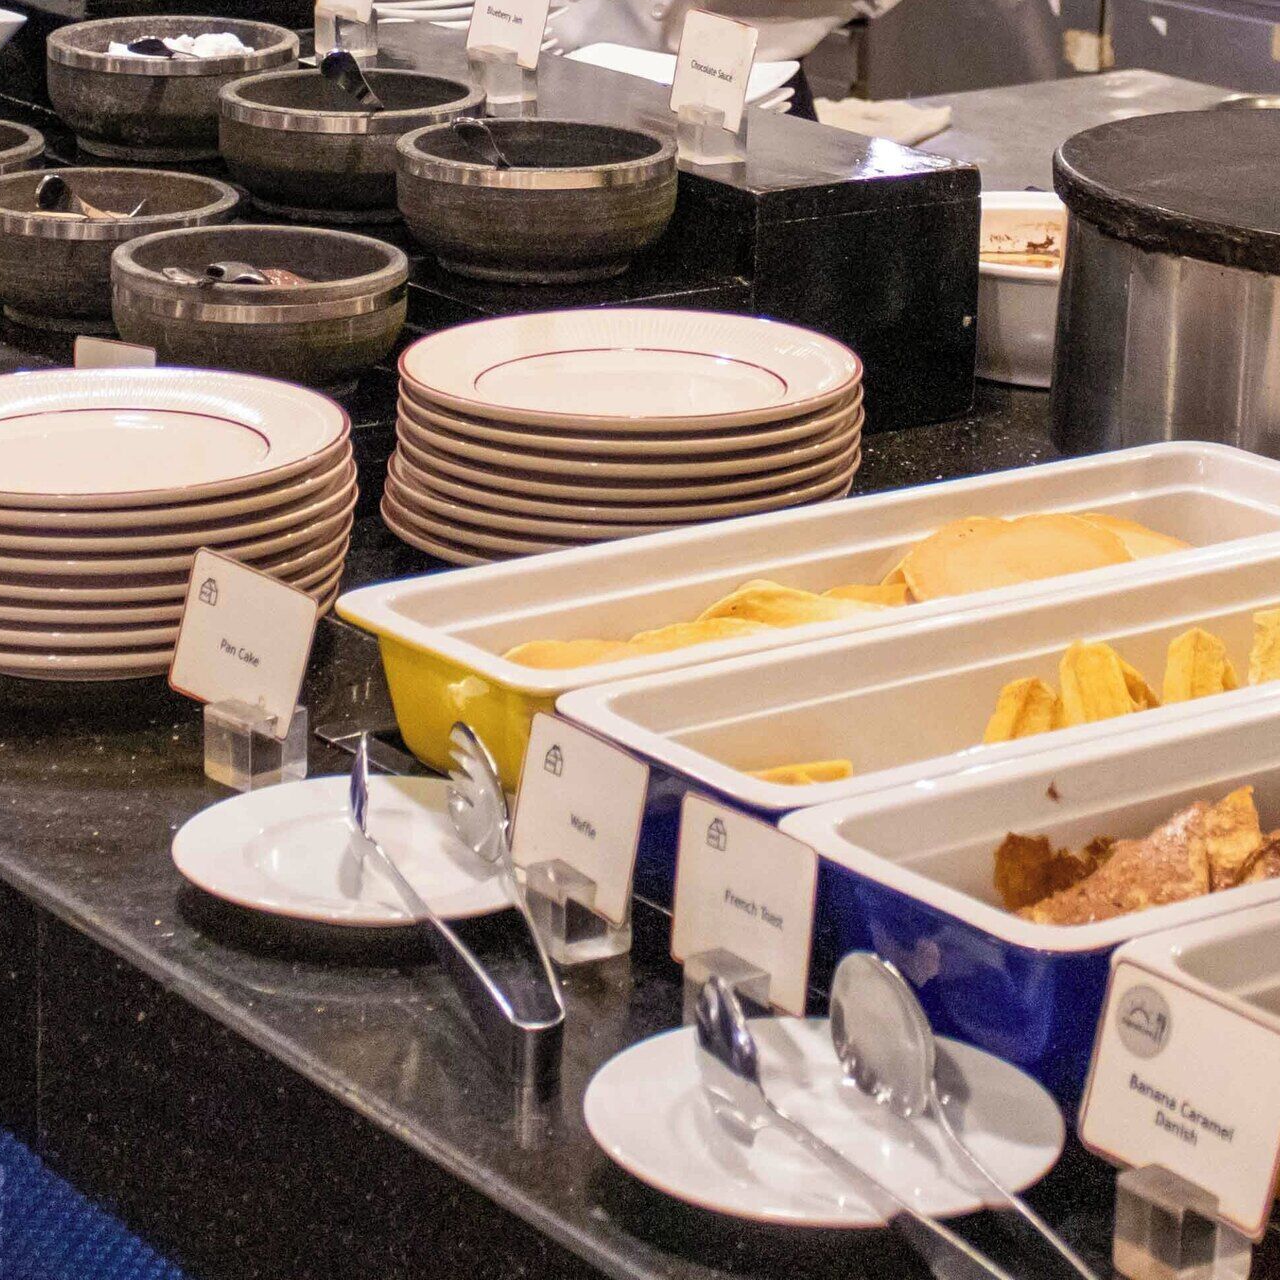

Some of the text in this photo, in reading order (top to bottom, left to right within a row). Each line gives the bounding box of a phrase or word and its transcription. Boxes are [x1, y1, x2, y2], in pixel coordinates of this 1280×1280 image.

[486, 5, 511, 24] Blueberry
[690, 59, 734, 83] Chocolate Sauce
[219, 637, 261, 668] Pan Cake
[570, 813, 597, 840] Waffle
[724, 888, 785, 932] French Toast
[1129, 1072, 1235, 1143] Banana Caramel
[1155, 1110, 1199, 1147] Danish
